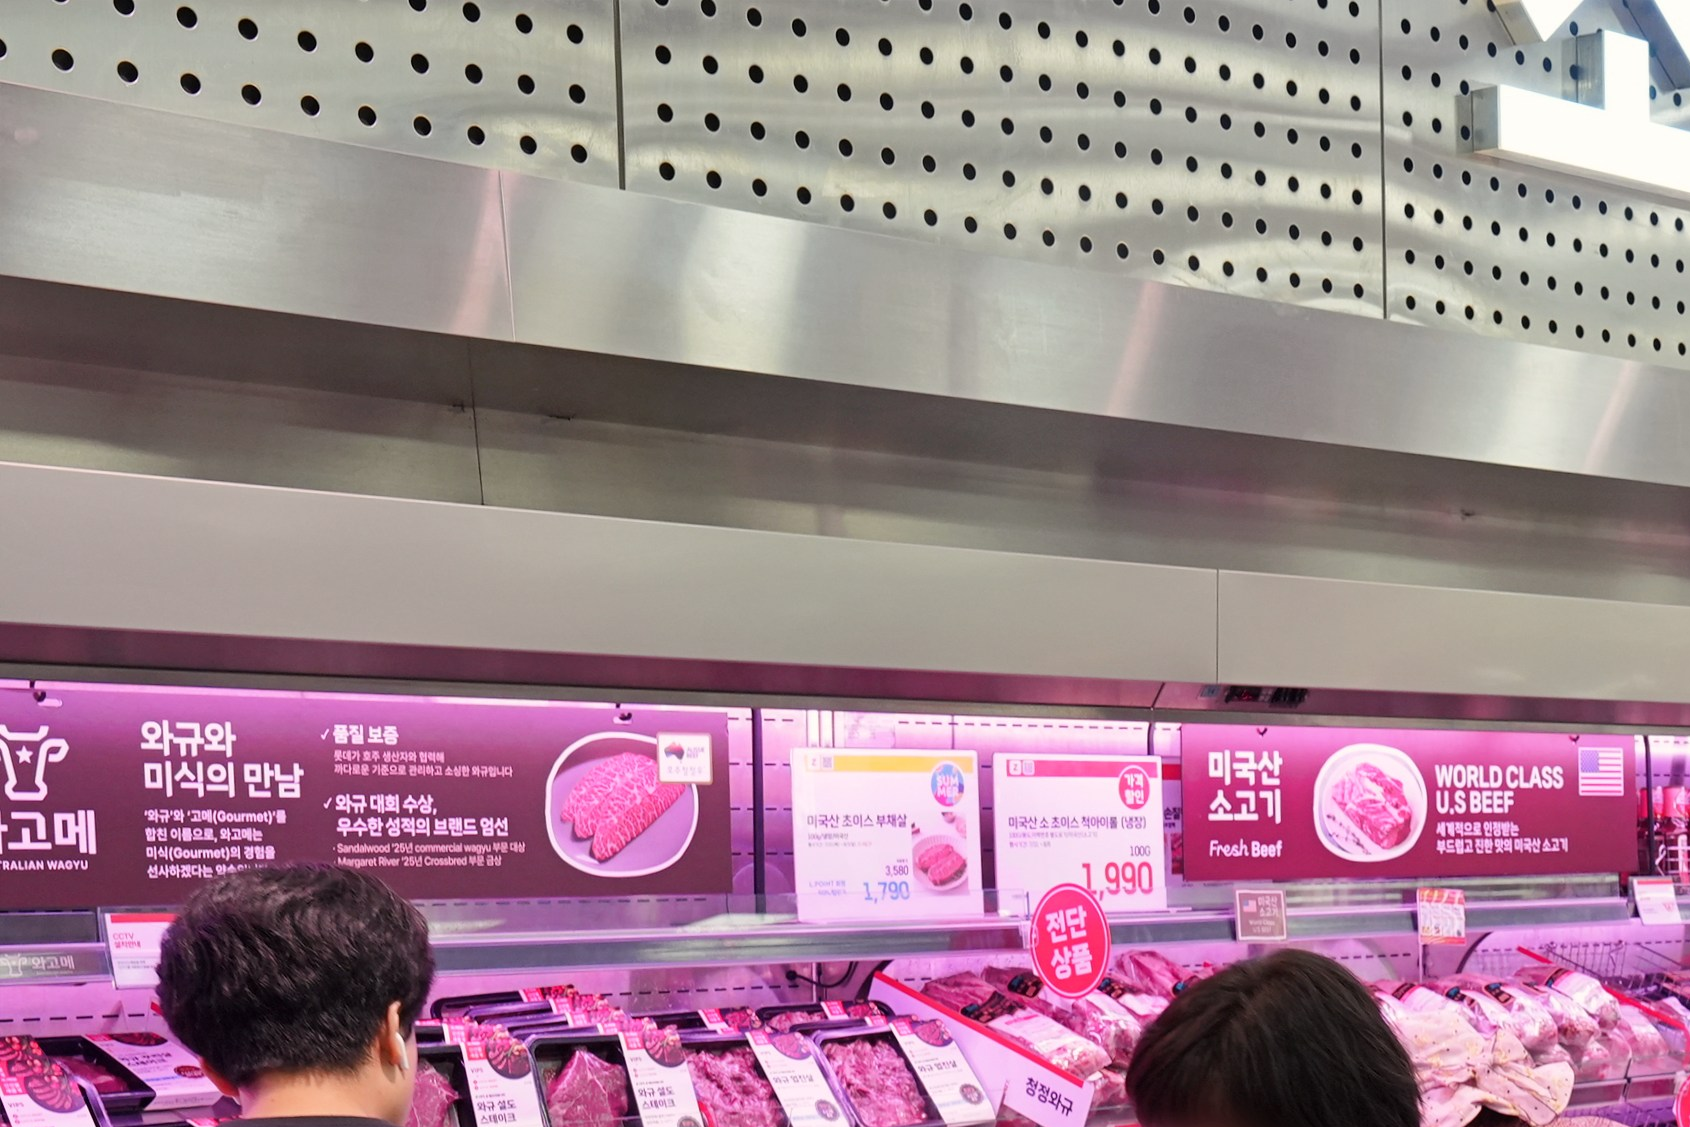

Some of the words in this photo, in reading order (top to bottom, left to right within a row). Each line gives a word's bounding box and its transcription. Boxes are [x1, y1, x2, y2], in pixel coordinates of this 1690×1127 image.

[140, 719, 237, 758] 와규와
[332, 724, 365, 745] 품질
[367, 725, 399, 745] 보증
[471, 766, 513, 778] 와규입니다
[1208, 750, 1284, 787] 미국산
[1434, 764, 1503, 789] WORLD
[1505, 765, 1564, 790] CLASS
[143, 760, 236, 798] 미식의
[243, 762, 305, 798] 만남
[1124, 772, 1144, 789] 가격
[335, 794, 368, 814] 와규
[369, 795, 400, 814] 대회
[402, 794, 438, 815] 수상,
[1208, 788, 1282, 825] 소고기
[1435, 790, 1467, 815] U.S
[1469, 791, 1515, 814] BEEF
[336, 817, 383, 837] 우수한
[385, 817, 431, 837] 성적의
[433, 818, 478, 836] 브랜드
[479, 817, 509, 836] 엄선
[807, 814, 840, 829] 미국산
[842, 815, 874, 828] 초이스
[876, 814, 907, 829] 부채살
[1009, 816, 1037, 829] 미국산
[1039, 817, 1050, 829] 소
[1051, 816, 1079, 829] 초이스
[1081, 816, 1118, 830] 척아이롤
[1121, 817, 1146, 830] (냉장)
[1436, 821, 1482, 837] 세계적으로
[1483, 821, 1520, 837] 인정받는
[0, 809, 98, 855] 고메
[145, 827, 168, 842] 합친
[170, 828, 218, 844] 이름으로,
[220, 828, 263, 842] 와고메는
[146, 846, 241, 861] 미식(Gourmet)의
[243, 847, 276, 861] 경험을
[336, 843, 391, 854] Sandalwood
[414, 844, 463, 854] commercial
[463, 845, 492, 856] wagyu
[1129, 845, 1151, 857] 100G
[1209, 838, 1249, 858] Fresh
[1251, 840, 1283, 858] Beef
[1436, 839, 1473, 855] 부드럽고
[1475, 838, 1494, 854] 진한
[1514, 838, 1541, 854] 미국산
[1542, 837, 1569, 853] 소고기
[47, 860, 89, 871] WAGYU
[424, 857, 468, 867] Crossbred
[147, 864, 213, 879] 선사하겠다는
[885, 865, 909, 877] 3,580
[1082, 861, 1154, 901] 1,990
[863, 880, 911, 904] 1,790
[1046, 905, 1087, 941] 전단
[113, 932, 134, 941] CCTV
[31, 954, 75, 971] 와고메
[1049, 947, 1094, 980] 상품
[638, 1087, 655, 1098] 와규
[656, 1086, 675, 1097] 설도
[1025, 1076, 1074, 1117] 청정와규
[476, 1101, 496, 1112] 와규
[497, 1099, 517, 1111] 설도
[642, 1098, 676, 1110] 스테이크
[480, 1113, 517, 1125] 스테이크
